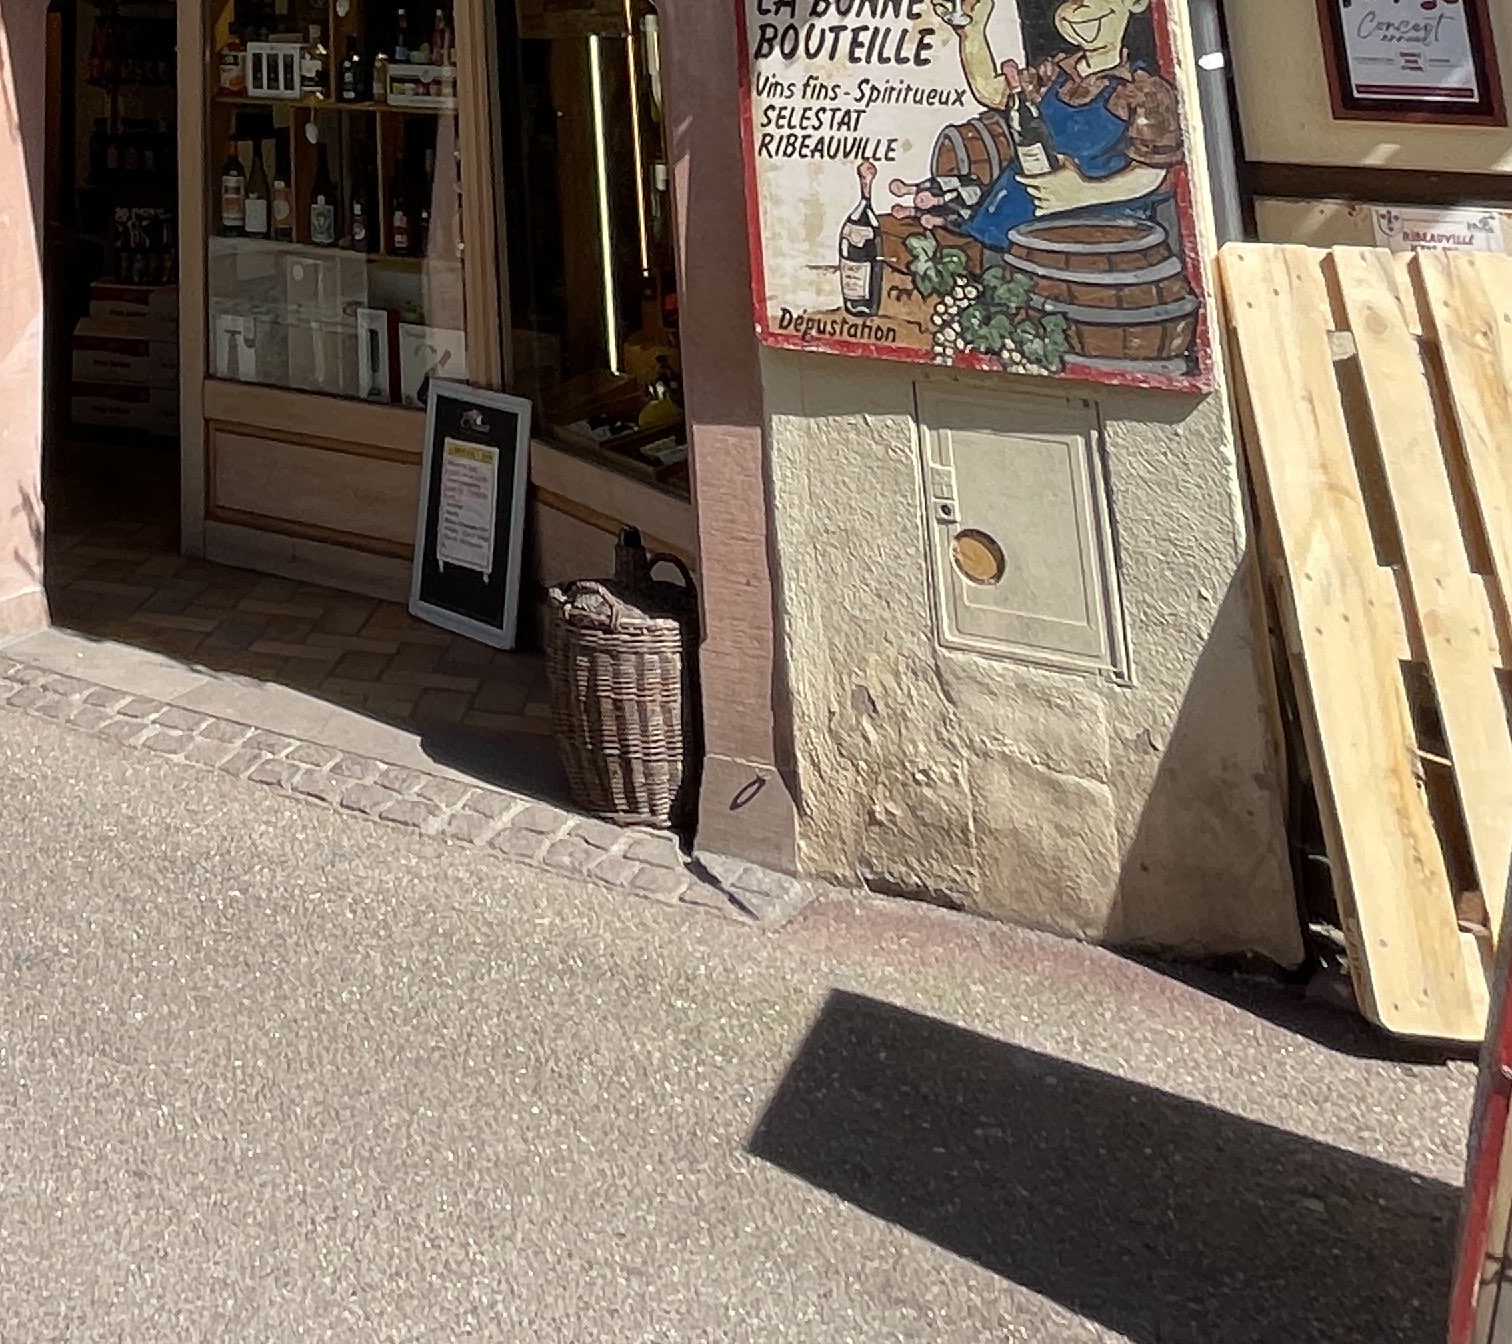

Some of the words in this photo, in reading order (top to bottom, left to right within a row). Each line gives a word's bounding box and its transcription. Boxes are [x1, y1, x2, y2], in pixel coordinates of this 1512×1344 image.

[754, 23, 936, 67] BOUTEILLE
[755, 71, 796, 100] Vins
[800, 73, 842, 102] fins
[853, 78, 967, 108] Spiritueux
[760, 105, 867, 133] SELESTAT
[758, 132, 899, 162] RIBEAUVILLE
[778, 306, 897, 343] Dégustation
